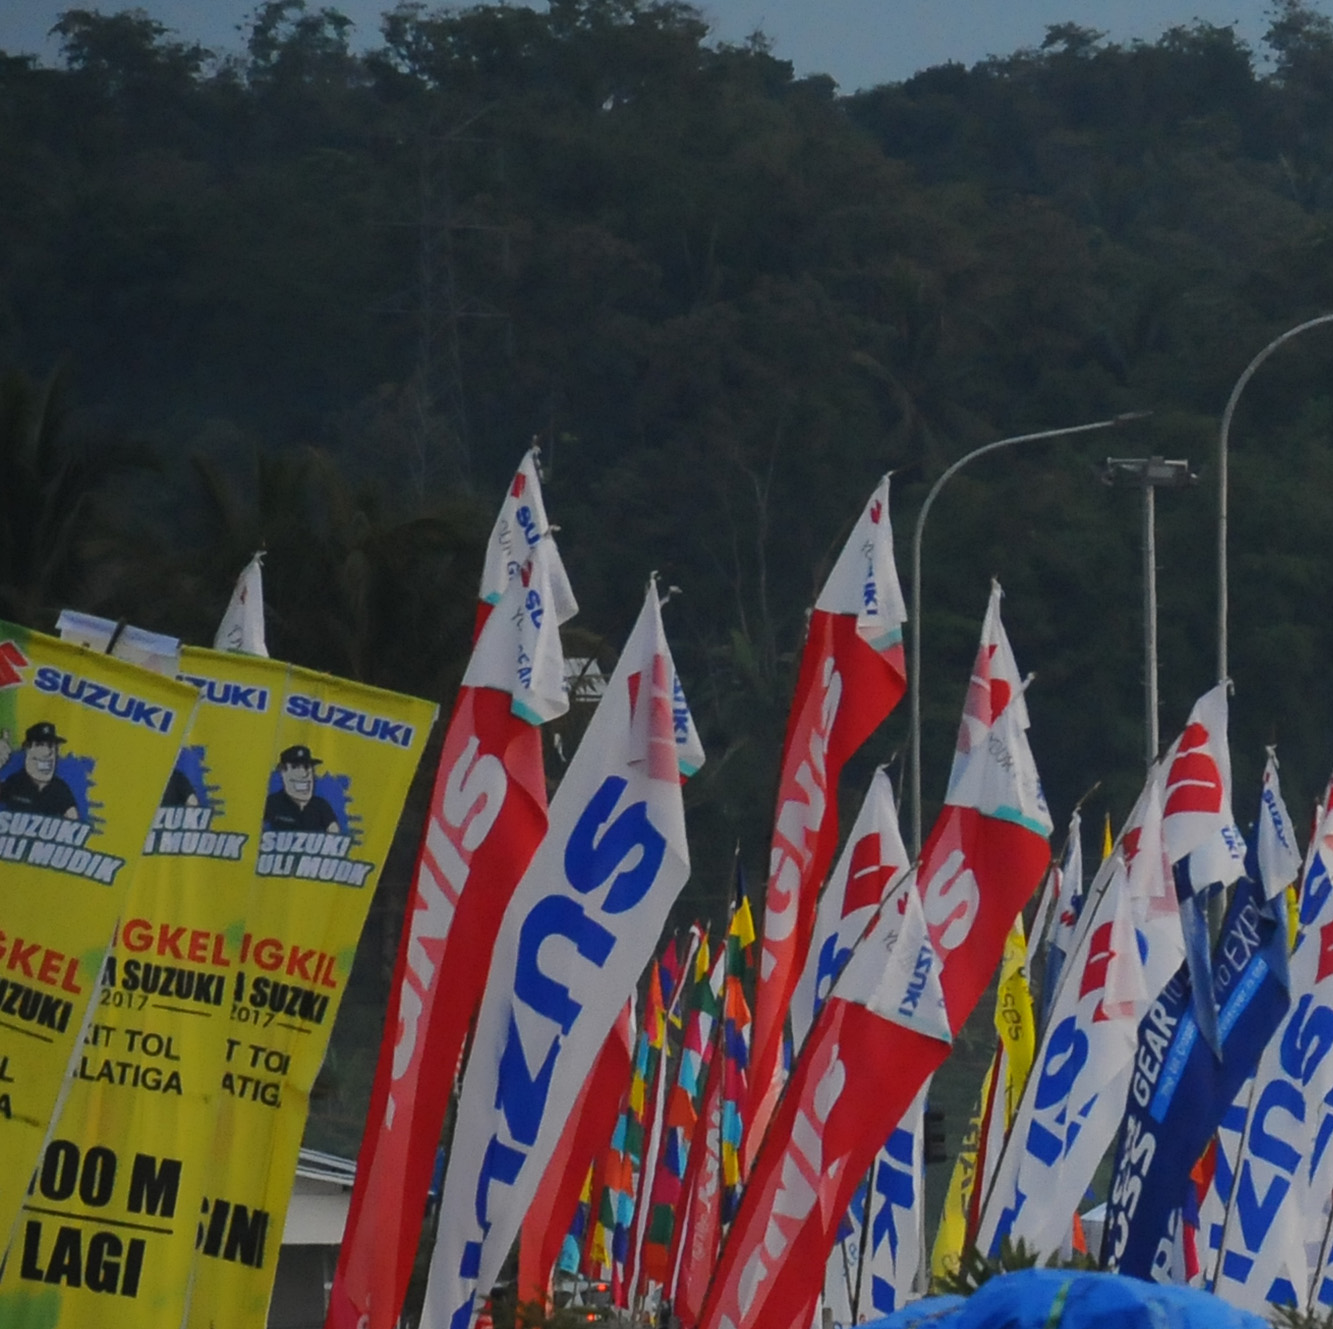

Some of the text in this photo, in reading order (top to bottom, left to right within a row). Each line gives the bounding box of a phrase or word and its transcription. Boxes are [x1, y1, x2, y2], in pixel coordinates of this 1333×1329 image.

[35, 668, 173, 733] SUZUKI
[287, 696, 413, 748] SUZUKI
[28, 840, 124, 884] MUDIK
[159, 832, 247, 858] MUDIK
[262, 832, 351, 857] SUZUKI
[101, 989, 148, 1011] 2017
[121, 959, 226, 1006] SUZUKI
[125, 1029, 181, 1062] TOL
[1133, 1002, 1178, 1108] GEAR
[126, 1153, 183, 1218] M
[19, 1219, 147, 1298] LAGI
